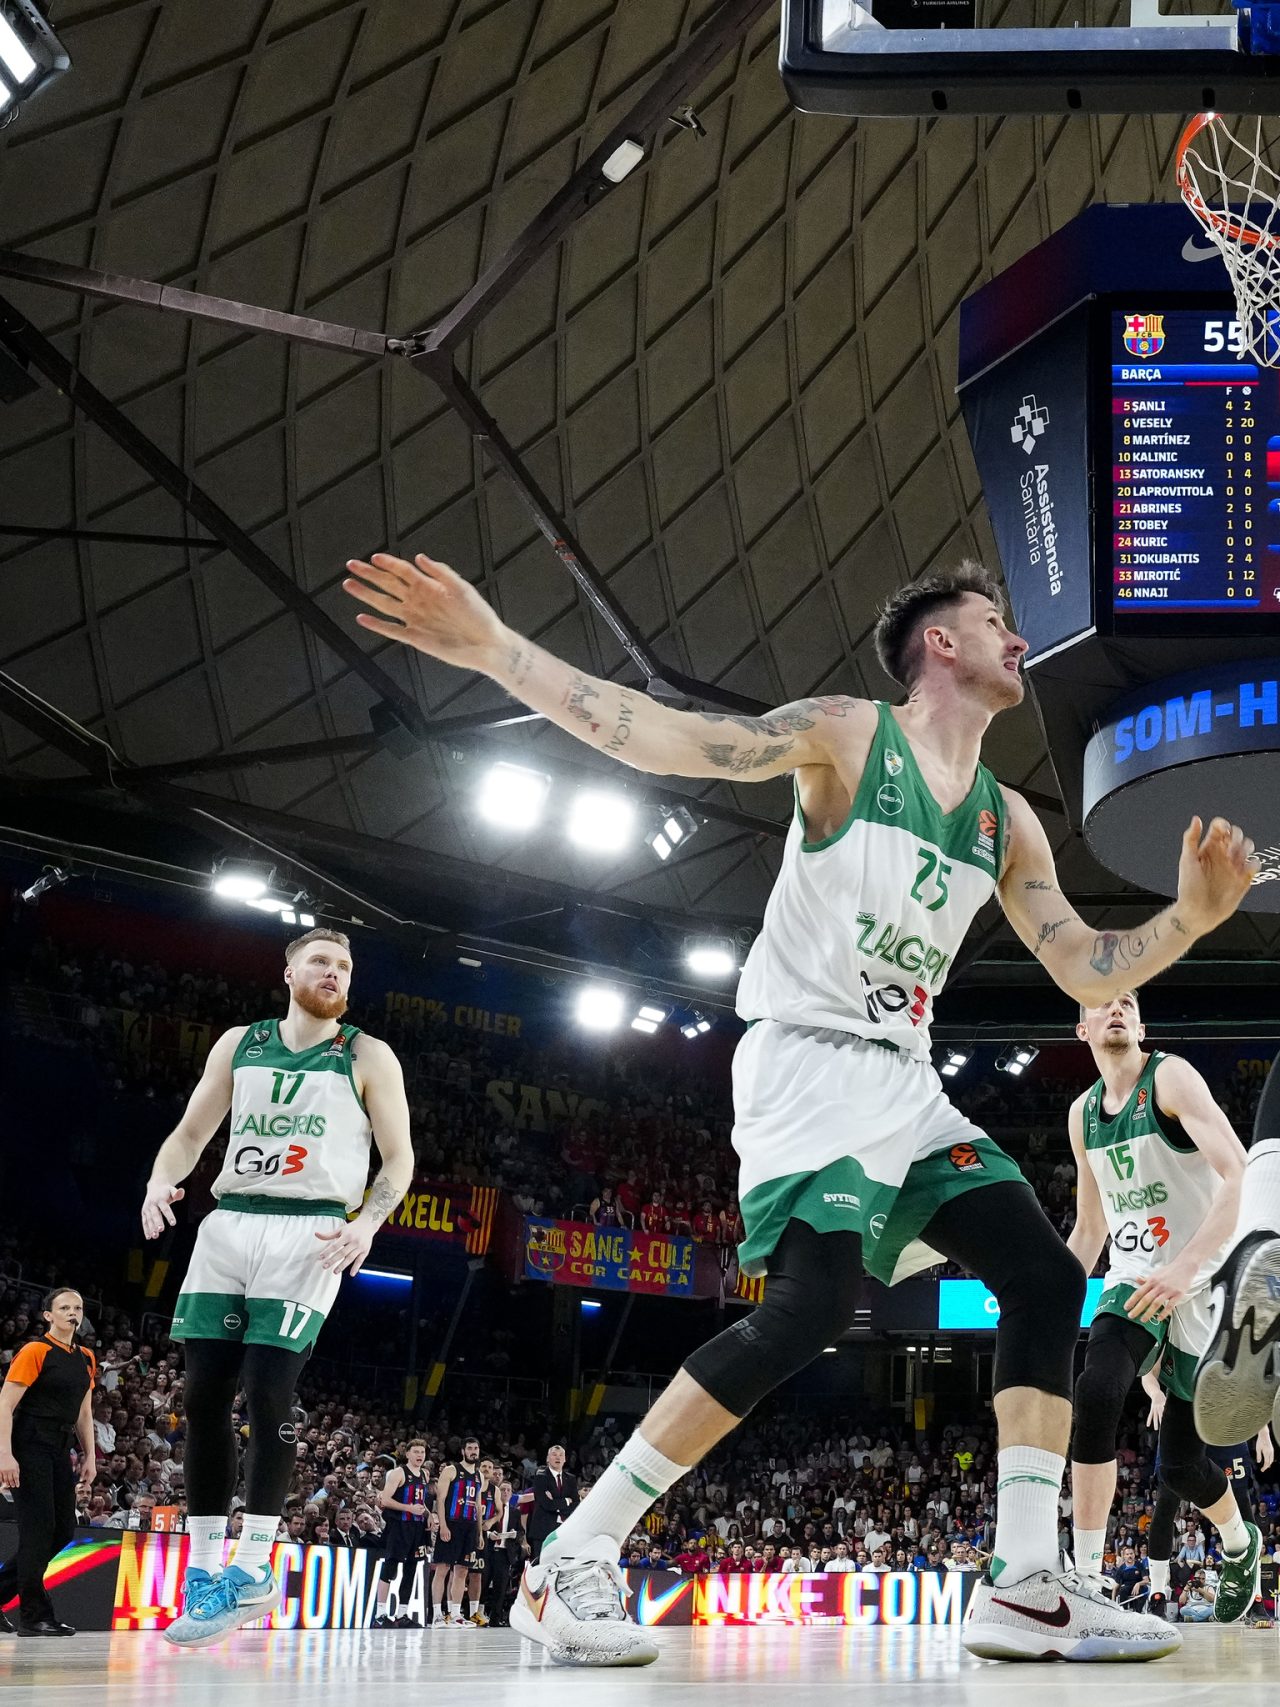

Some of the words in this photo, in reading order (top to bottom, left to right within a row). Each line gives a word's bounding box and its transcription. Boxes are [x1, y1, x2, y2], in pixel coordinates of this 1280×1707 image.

[1203, 321, 1246, 352] 55
[1121, 368, 1162, 382] BARÇA
[1225, 386, 1233, 396] F
[1124, 401, 1131, 411] 5
[1132, 401, 1166, 413] ŞANLI
[1225, 400, 1233, 410] 4
[1244, 400, 1251, 410] 2
[1124, 418, 1131, 428] 6
[1132, 418, 1173, 428] VESELY
[1225, 417, 1233, 427] 2
[1241, 417, 1254, 427] 20
[1124, 435, 1131, 445] 8
[1132, 433, 1190, 445] MARTÍNEZ
[1226, 434, 1234, 444] 0
[1244, 434, 1251, 444] 0
[1118, 452, 1131, 462] 10
[1132, 452, 1178, 462] KALINIC
[1226, 451, 1234, 461] 0
[1244, 451, 1251, 461] 8
[1119, 469, 1131, 479] 13
[1132, 469, 1205, 479] SATORANSKY
[1227, 468, 1233, 478] 1
[1244, 468, 1252, 478] 4
[1118, 487, 1132, 497] 20
[1133, 487, 1214, 497] LAPROVITTOLA
[1226, 486, 1234, 496] 0
[1244, 486, 1252, 496] 0
[1119, 504, 1132, 513] 21
[1133, 504, 1182, 513] ABRINES
[1226, 503, 1234, 512] 2
[1244, 503, 1251, 512] 5
[1019, 470, 1042, 566] Sanitària
[1118, 520, 1132, 530] 23
[1133, 520, 1168, 530] TOBEY
[1227, 519, 1233, 529] 1
[1244, 519, 1252, 529] 0
[1033, 464, 1064, 597] Assistència
[1118, 537, 1132, 547] 24
[1133, 537, 1168, 547] KURIC
[1226, 536, 1234, 546] 0
[1245, 536, 1252, 546] 0
[1120, 554, 1132, 564] 31
[1133, 554, 1200, 564] JOKUBAITIS
[1227, 553, 1235, 563] 2
[1244, 553, 1252, 563] 4
[1119, 571, 1132, 581] 33
[1133, 568, 1181, 581] MIROTIĆ
[1228, 570, 1234, 580] 1
[1243, 570, 1255, 580] 12
[1118, 588, 1132, 598] 46
[1134, 588, 1168, 598] NNAJI
[1227, 587, 1235, 597] 0
[1245, 587, 1252, 597] 0
[909, 847, 953, 911] 25
[454, 1005, 522, 1038] CULER
[270, 1071, 306, 1105] 17
[234, 1144, 308, 1177] Go3
[1106, 1143, 1135, 1181] 15
[570, 1230, 624, 1263] SANG
[570, 1262, 606, 1278] COR
[278, 1300, 313, 1339] 17
[465, 1485, 475, 1497] 10
[154, 1513, 165, 1532] 5
